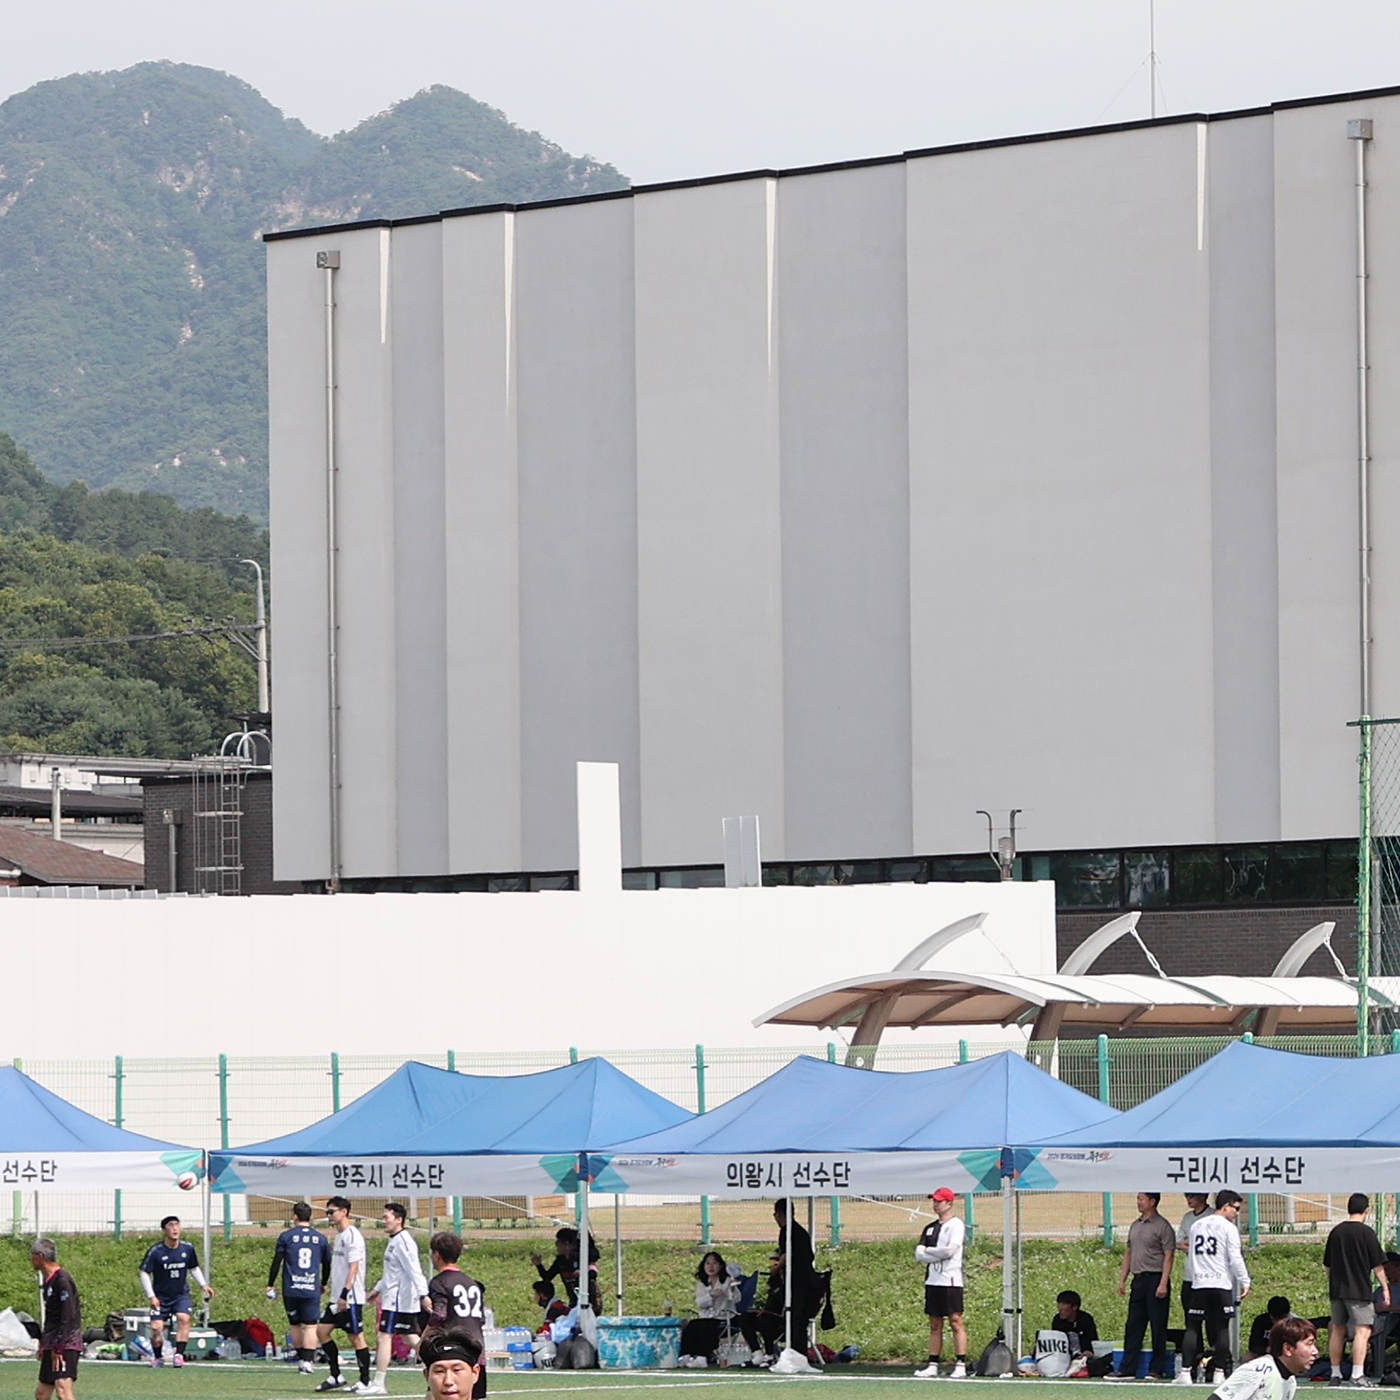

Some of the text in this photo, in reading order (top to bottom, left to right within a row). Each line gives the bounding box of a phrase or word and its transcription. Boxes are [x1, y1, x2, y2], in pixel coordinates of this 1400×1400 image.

[2, 1160, 58, 1183] 선수단
[332, 1163, 445, 1189] 양주시 선수단
[726, 1161, 851, 1189] 의왕시 선수단
[1166, 1156, 1305, 1185] 구리시 선수단
[1194, 1235, 1218, 1256] 23
[298, 1247, 312, 1269] 8
[453, 1283, 483, 1319] 32
[1033, 1338, 1067, 1353] NIKE
